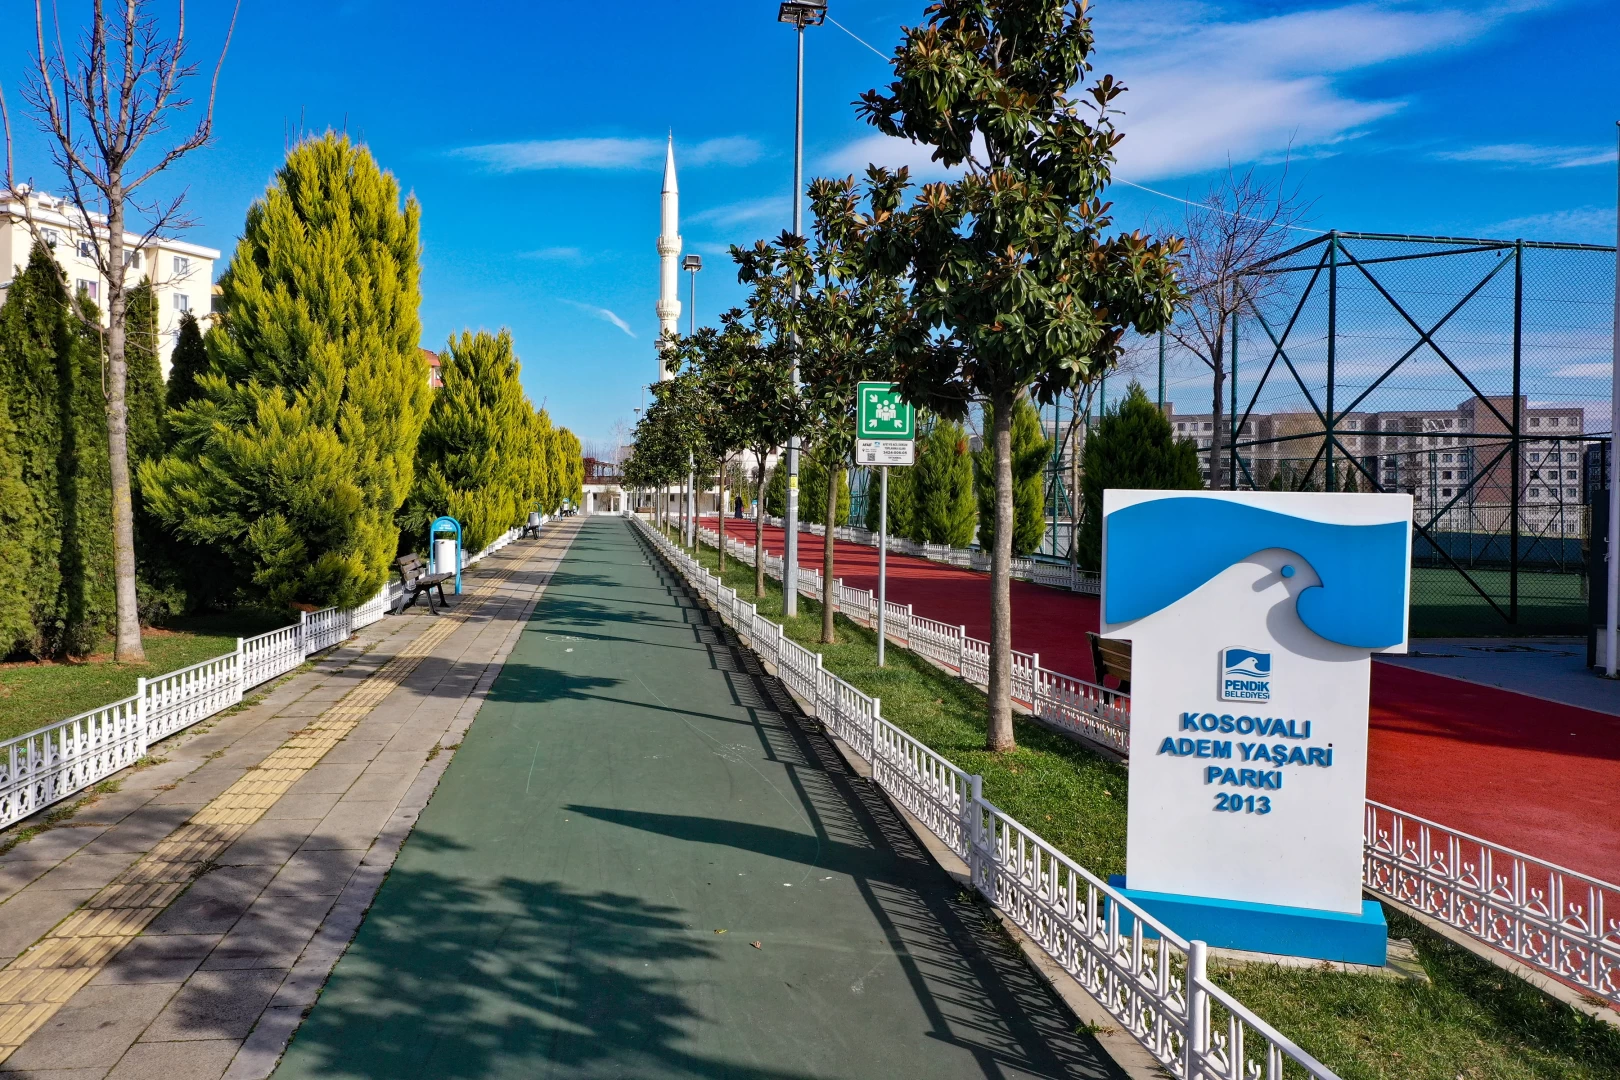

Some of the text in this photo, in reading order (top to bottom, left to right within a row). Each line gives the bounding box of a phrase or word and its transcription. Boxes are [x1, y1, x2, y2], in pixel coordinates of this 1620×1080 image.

[1182, 712, 1311, 739] KOSOVALI
[1158, 737, 1232, 759] ADEM
[1206, 766, 1282, 789] PARKI
[1213, 792, 1271, 814] 2013
